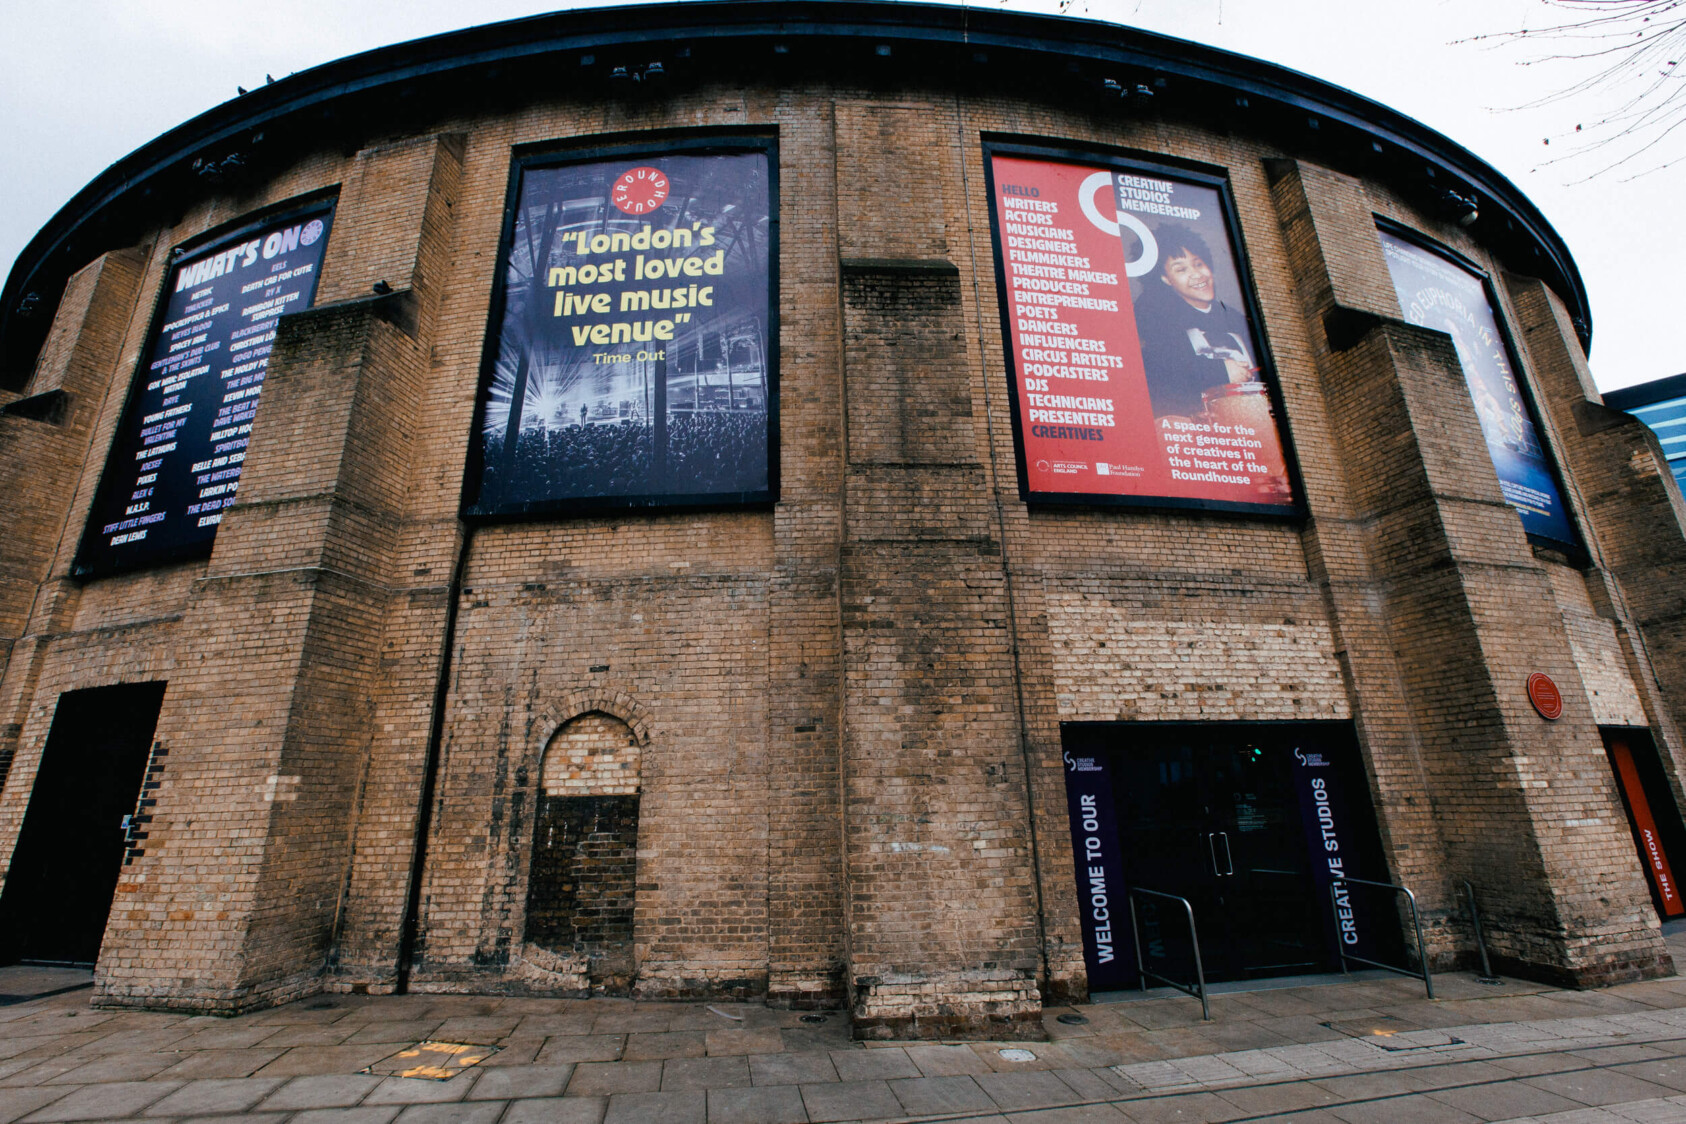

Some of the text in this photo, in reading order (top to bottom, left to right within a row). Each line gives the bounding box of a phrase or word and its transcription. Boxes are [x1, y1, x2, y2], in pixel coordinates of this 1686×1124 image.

[617, 170, 666, 211] ROUNDHOUSE
[1001, 184, 1040, 198] HELLO
[1117, 174, 1174, 194] CREATIVE
[1119, 186, 1171, 204] STUDIOS
[1003, 196, 1058, 213] WRITERS
[1121, 198, 1201, 220] MEMBERSHIP
[1005, 209, 1053, 225] ACTORS
[1006, 222, 1075, 241] MUSICIANS
[1007, 236, 1077, 254] DESIGNERS
[175, 225, 302, 293] WHAT'S ON
[271, 260, 288, 273] EELS
[548, 249, 725, 287] most loved
[1009, 249, 1090, 269] FILMMAKERS
[241, 263, 313, 294] DEATH CAB FOR CUTIE
[1010, 262, 1118, 285] THEATRE MAKERS
[1012, 277, 1090, 296] PRODUCERS
[241, 291, 300, 317] RAINBOW KITTEN
[553, 284, 714, 317] live music
[1014, 290, 1119, 312] ENTREPRENEURS
[211, 303, 230, 317] EPICA
[251, 304, 285, 322] SURPRISE
[1016, 304, 1058, 320] POETS
[191, 320, 213, 335] BLOOD
[231, 319, 275, 340] BLACKBERRY
[1018, 319, 1078, 336] DANCERS
[169, 338, 192, 353] SPACEY
[190, 346, 205, 358] DUB
[204, 340, 221, 353] CLUB
[229, 334, 265, 352] CHRISTIAN
[1019, 333, 1106, 353] INFLUENCERS
[1416, 287, 1476, 329] EUPHORIA
[1479, 326, 1492, 347] IN
[1493, 350, 1517, 395] THIS
[232, 350, 253, 363] GOGO
[593, 349, 665, 365] Time Out
[1022, 348, 1124, 369] CIRCUS ARTISTS
[168, 362, 180, 373] THE
[177, 364, 210, 382] ISOLATION
[221, 367, 235, 380] THE
[234, 360, 259, 376] MOLDY
[1023, 363, 1109, 382] PODCASTERS
[227, 378, 240, 390] THE
[240, 375, 254, 387] BIG
[1025, 377, 1049, 392] DJS
[223, 389, 246, 404] KEVIN
[1027, 393, 1115, 412] TECHNICIANS
[143, 402, 193, 425] YOUNG FATHERS
[218, 406, 232, 418] THE
[232, 401, 251, 414] BEAT
[1029, 408, 1116, 427] PRESENTERS
[140, 417, 188, 438] BULLET FOR MY
[213, 415, 233, 428] DAVE
[1162, 418, 1255, 436] A space for the
[144, 429, 177, 446] VALENTINE
[210, 427, 238, 442] HILLTOP
[1031, 424, 1105, 441] CREATIVES
[1164, 432, 1262, 449] next generation
[135, 449, 149, 461] THE
[1166, 443, 1256, 460] of creatives in
[191, 460, 212, 473] BELLE
[212, 456, 228, 468] AND
[1168, 456, 1268, 474] the heart of the
[136, 472, 158, 486] PIXIES
[196, 473, 211, 485] THE
[1171, 469, 1251, 485] Roundhouse
[131, 488, 148, 501] ALEX
[199, 484, 227, 499] LARKIN
[187, 503, 201, 515] THE
[201, 499, 222, 512] DEAD
[103, 511, 167, 535] STIFF LITTLE FINGERS
[110, 533, 129, 547] DEAN
[1311, 777, 1339, 852] STUDIOS
[1643, 829, 1673, 902] THE SHOW
[1080, 794, 1115, 964] WELCOME TO OUR
